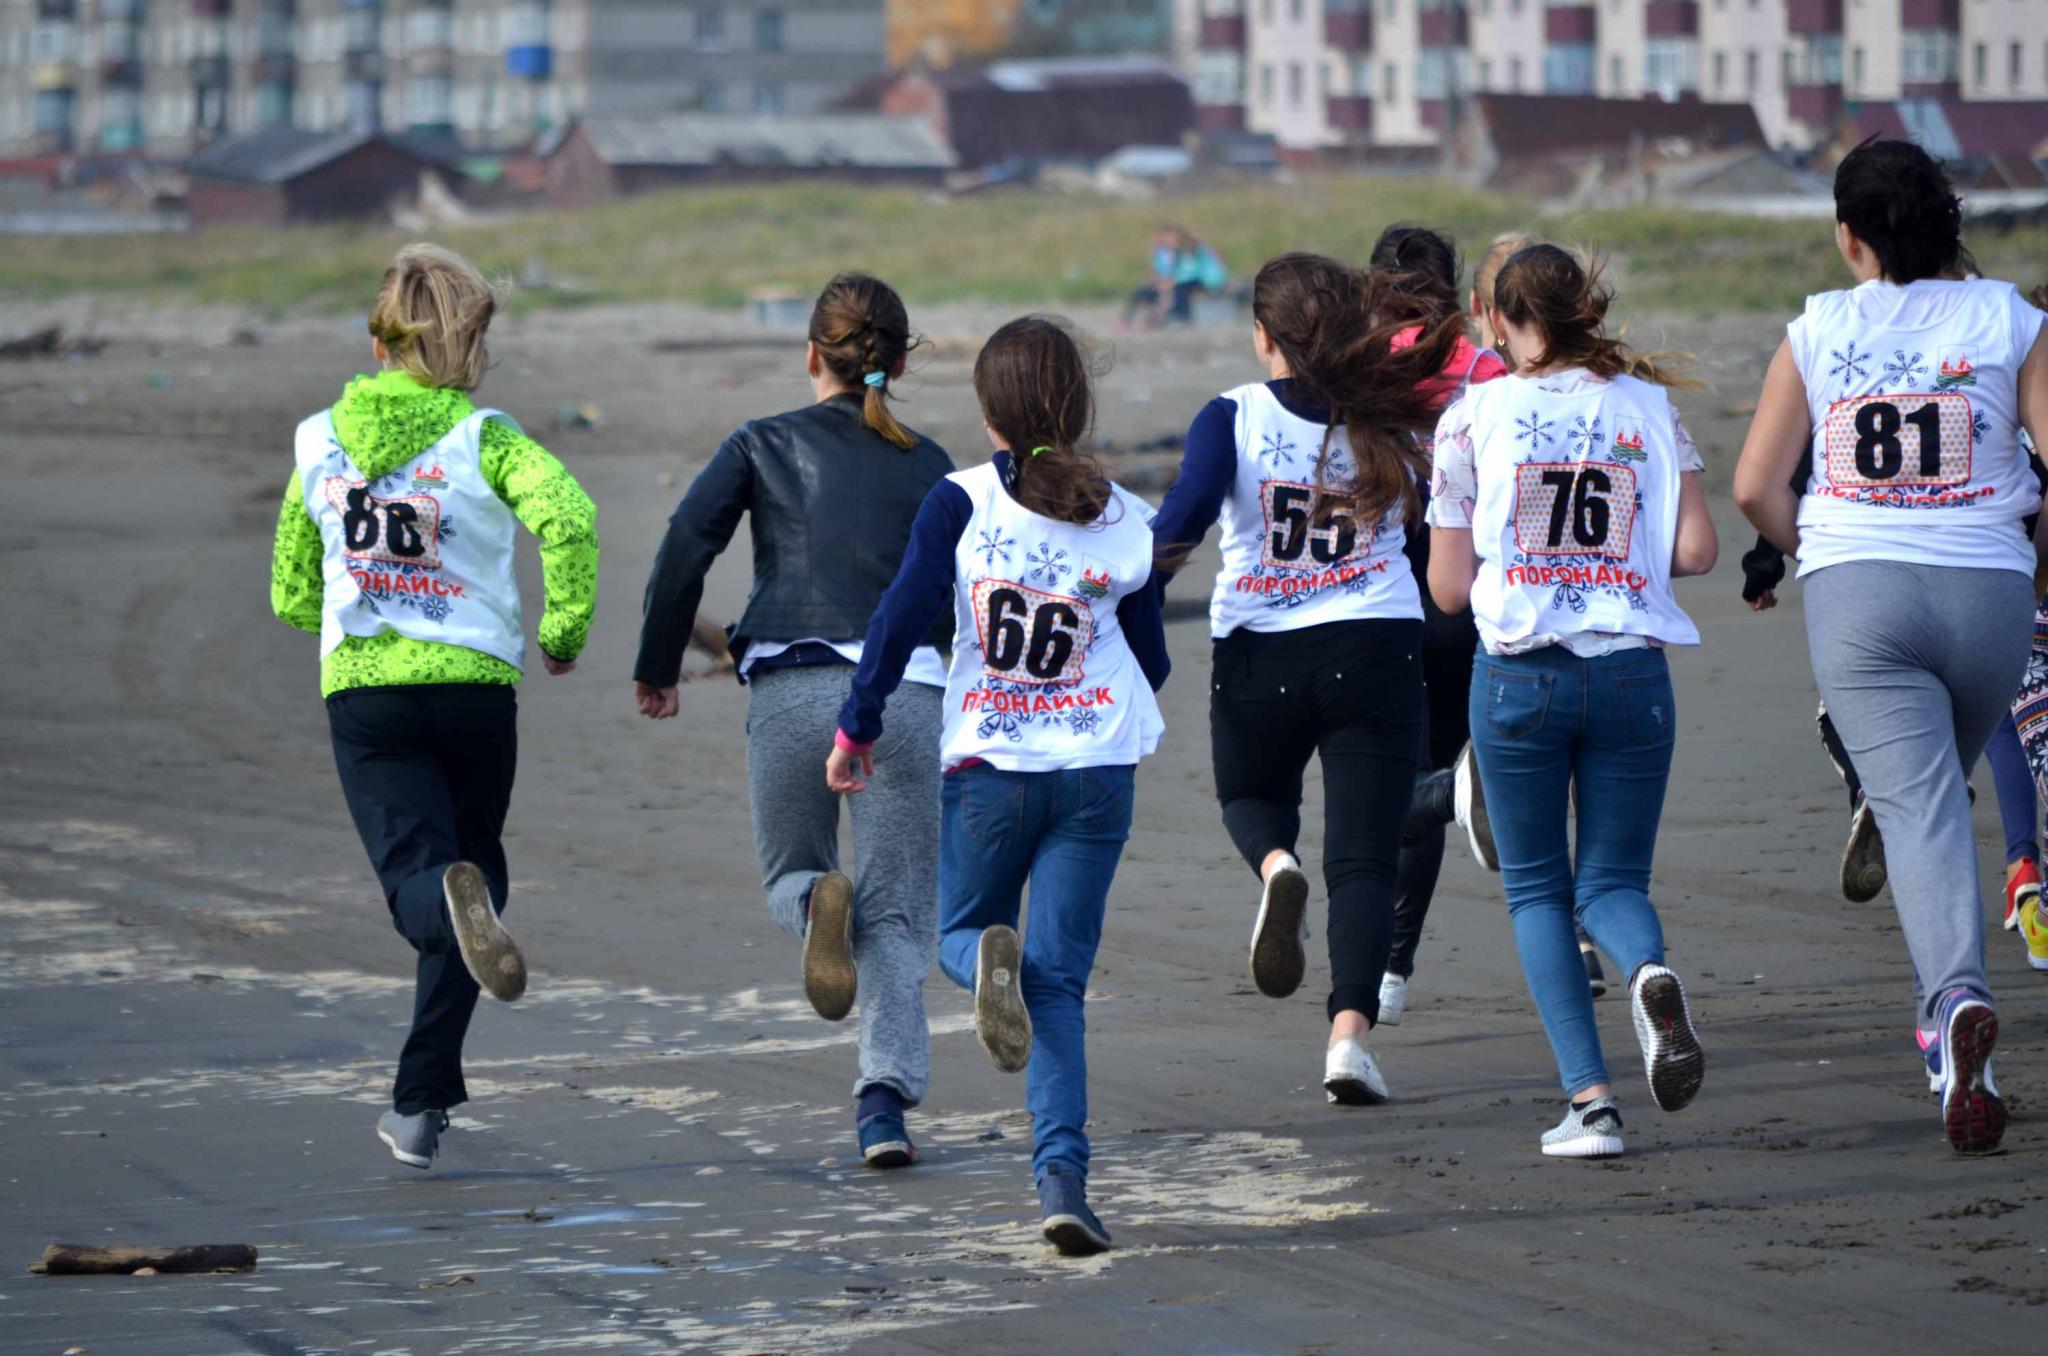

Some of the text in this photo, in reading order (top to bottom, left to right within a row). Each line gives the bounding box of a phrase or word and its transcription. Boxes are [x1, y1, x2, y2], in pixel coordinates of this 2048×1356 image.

[1855, 402, 1941, 480] 81
[1272, 485, 1357, 564] 55
[1542, 468, 1612, 547] 76
[985, 588, 1079, 679] 66
